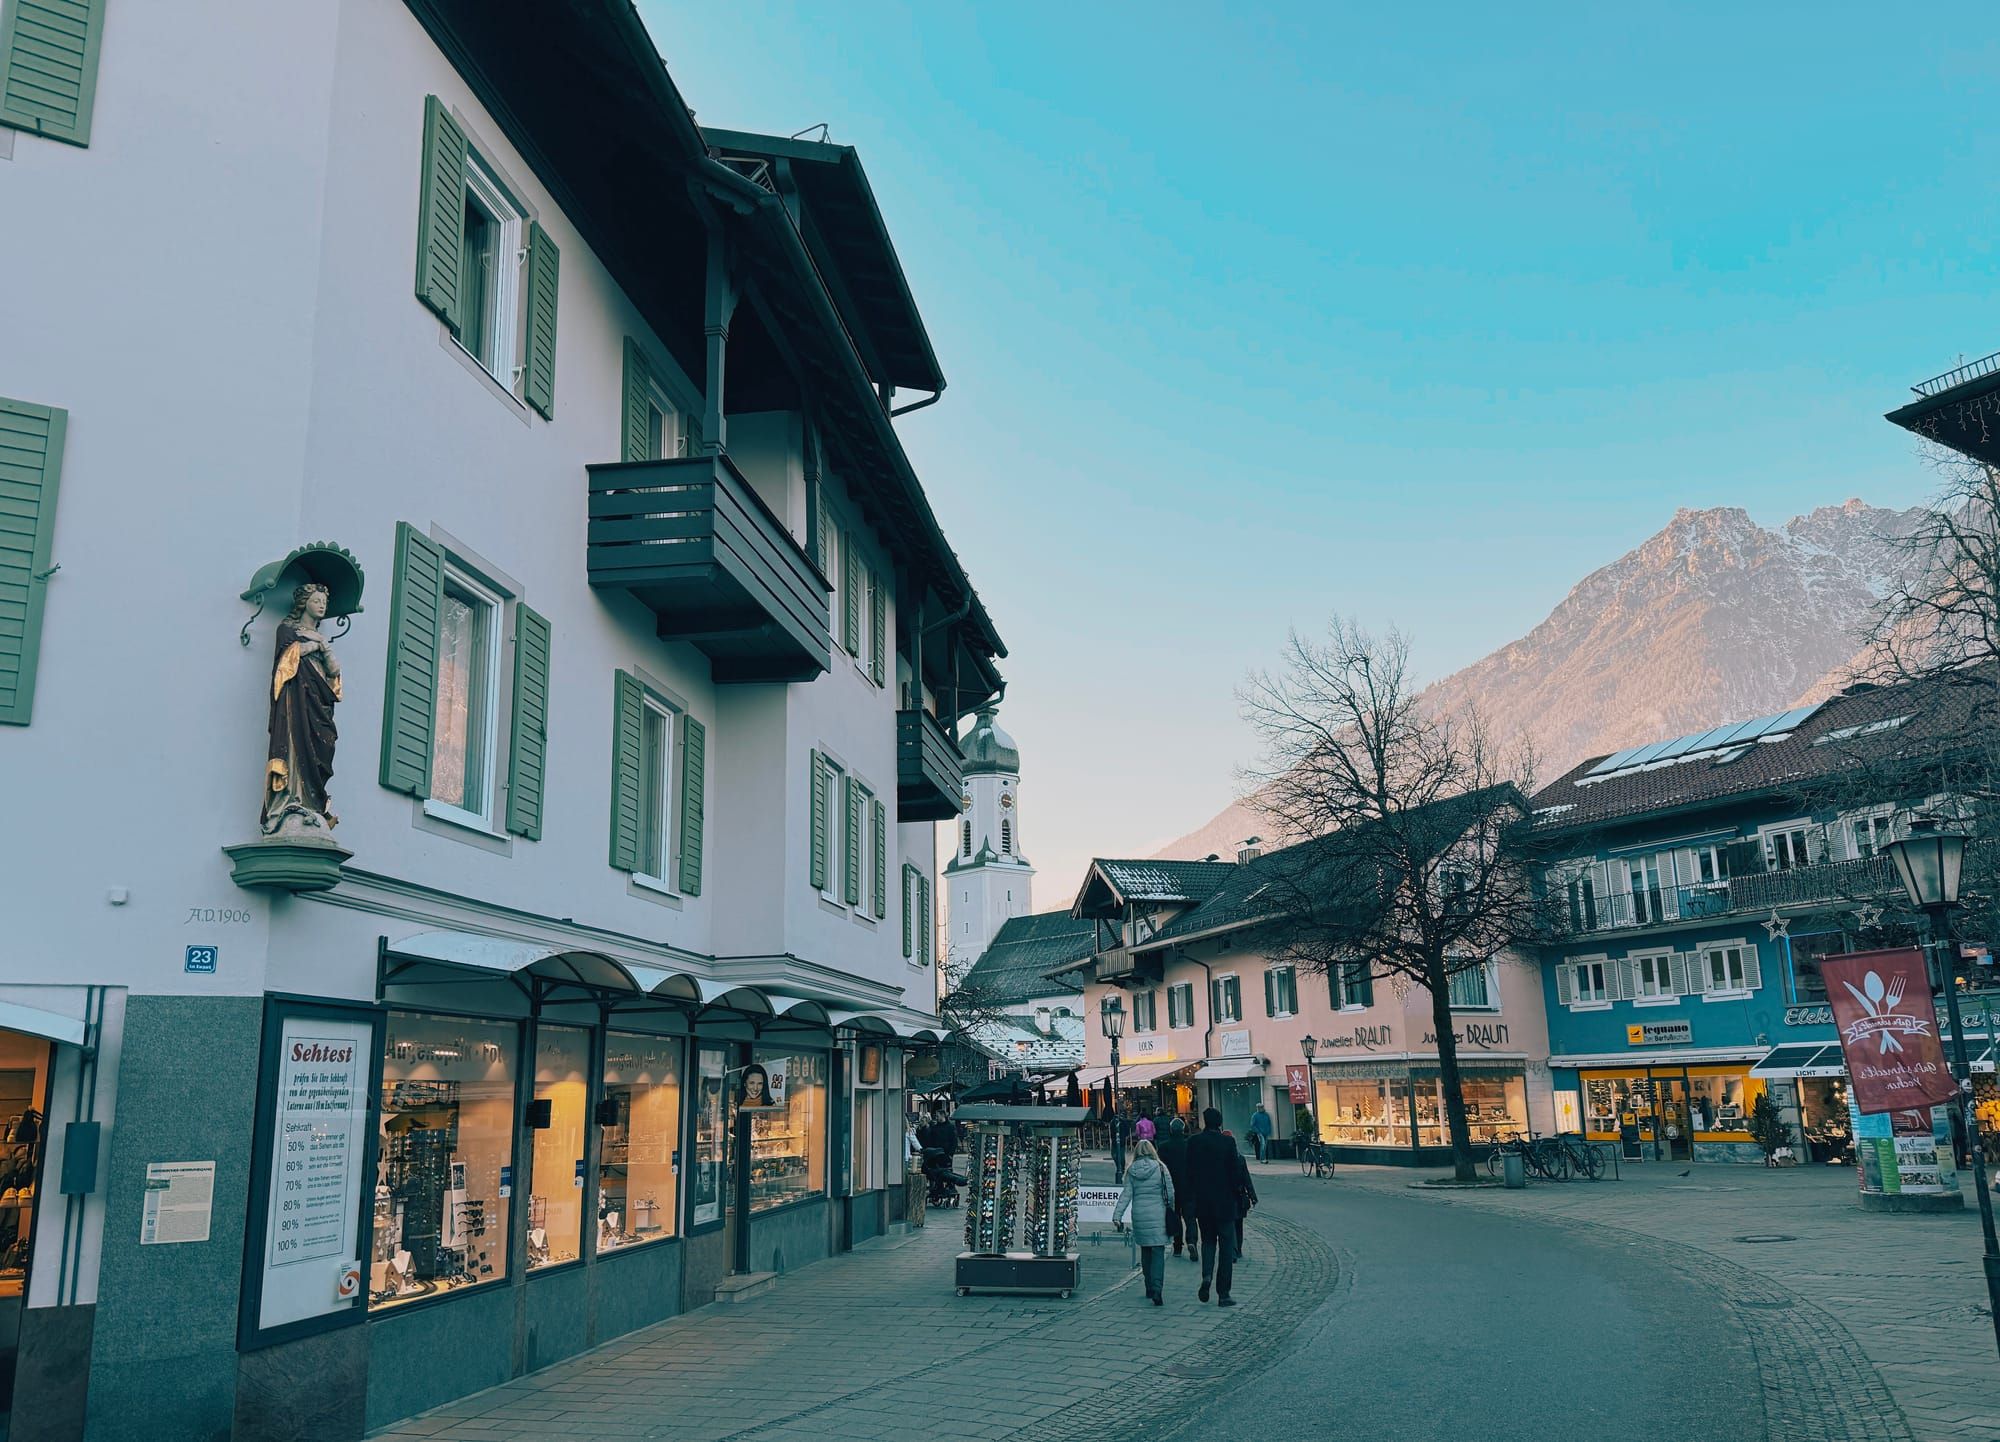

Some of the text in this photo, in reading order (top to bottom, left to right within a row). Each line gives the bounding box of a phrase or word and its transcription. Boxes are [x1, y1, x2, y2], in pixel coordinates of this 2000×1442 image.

[191, 950, 212, 963] 23
[1466, 1024, 1509, 1049] BRAUN
[1643, 1025, 1689, 1035] leguano
[1320, 1025, 1391, 1051] Juwelier BRAUN
[291, 1043, 353, 1063] Sehtest
[285, 1122, 312, 1133] Sehkraft
[1076, 1192, 1119, 1200] UCHELER
